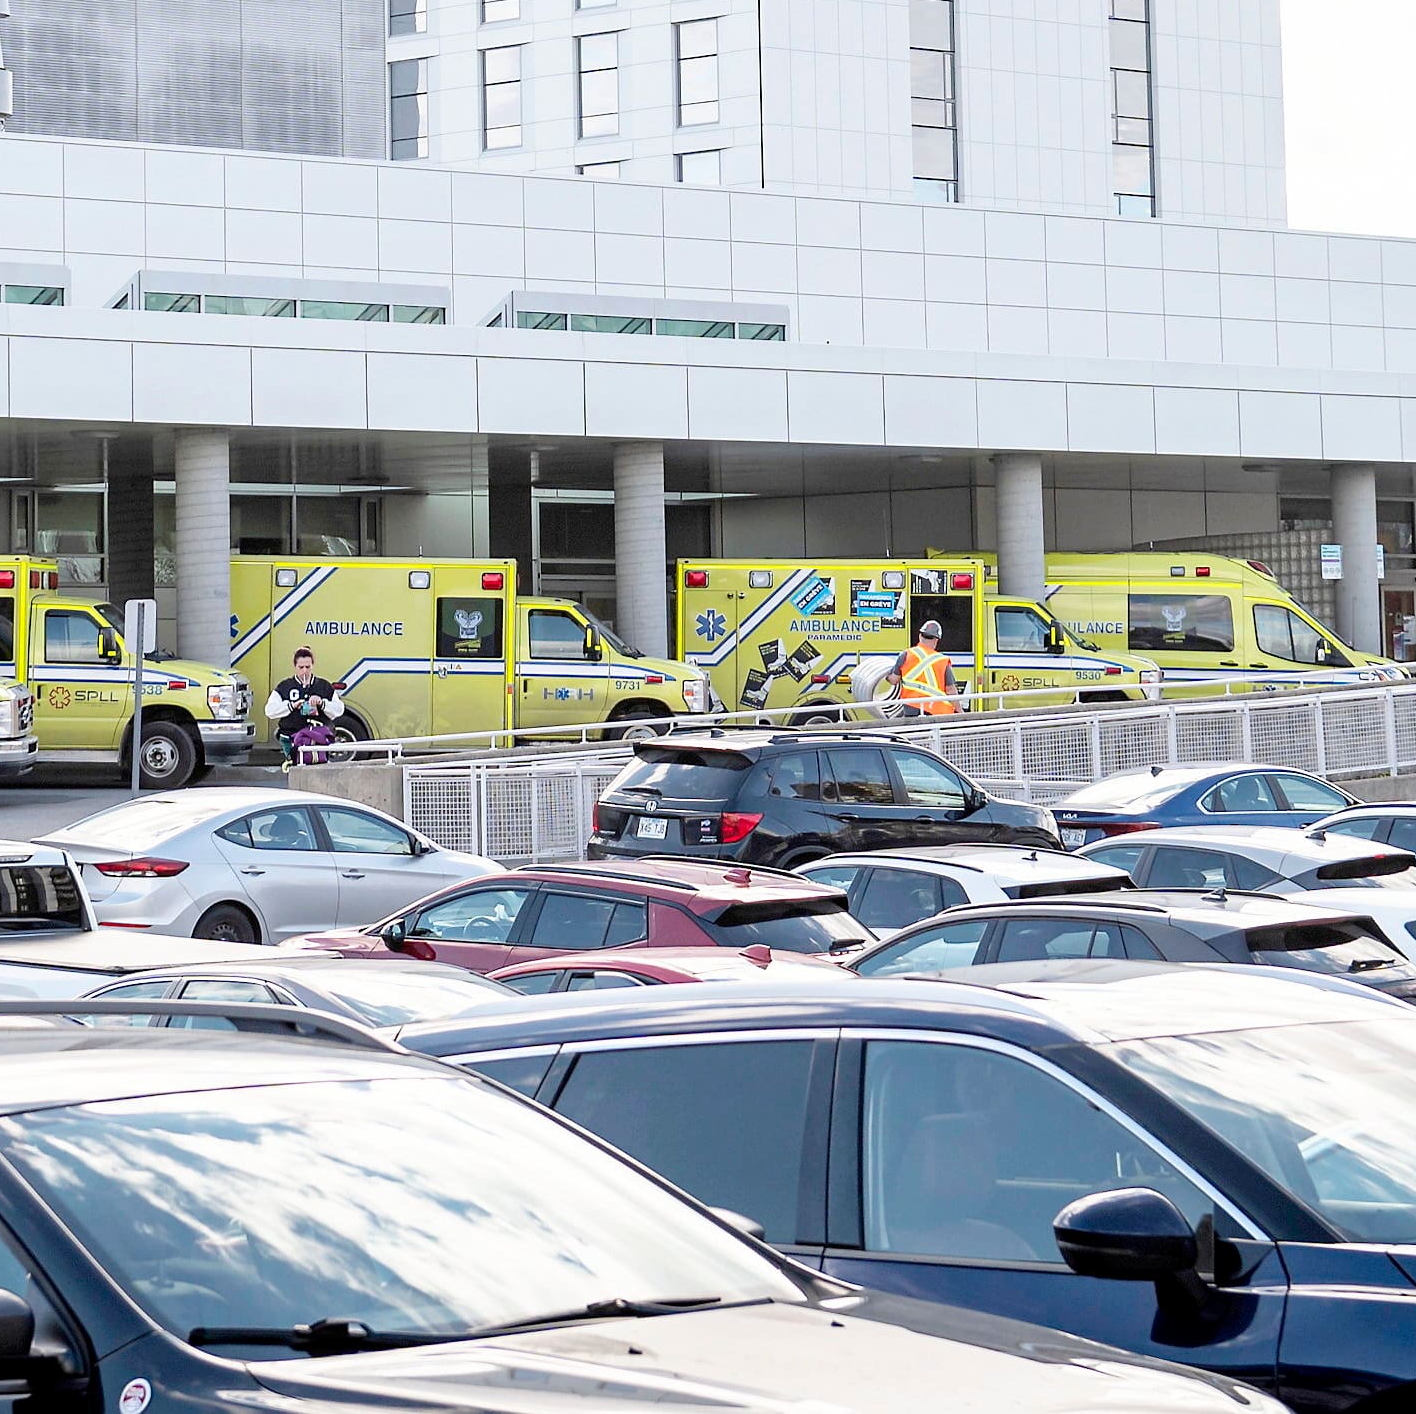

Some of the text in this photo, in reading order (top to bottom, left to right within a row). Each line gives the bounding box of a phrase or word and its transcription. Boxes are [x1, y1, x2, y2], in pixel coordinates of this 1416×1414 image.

[305, 621, 403, 636] AMBULANCE
[790, 619, 880, 632] AMBULANCE
[1075, 671, 1101, 681] 9530
[615, 680, 641, 691] 9731
[1022, 678, 1060, 687] SPLL
[74, 690, 119, 702] SPLL
[289, 689, 300, 701] G
